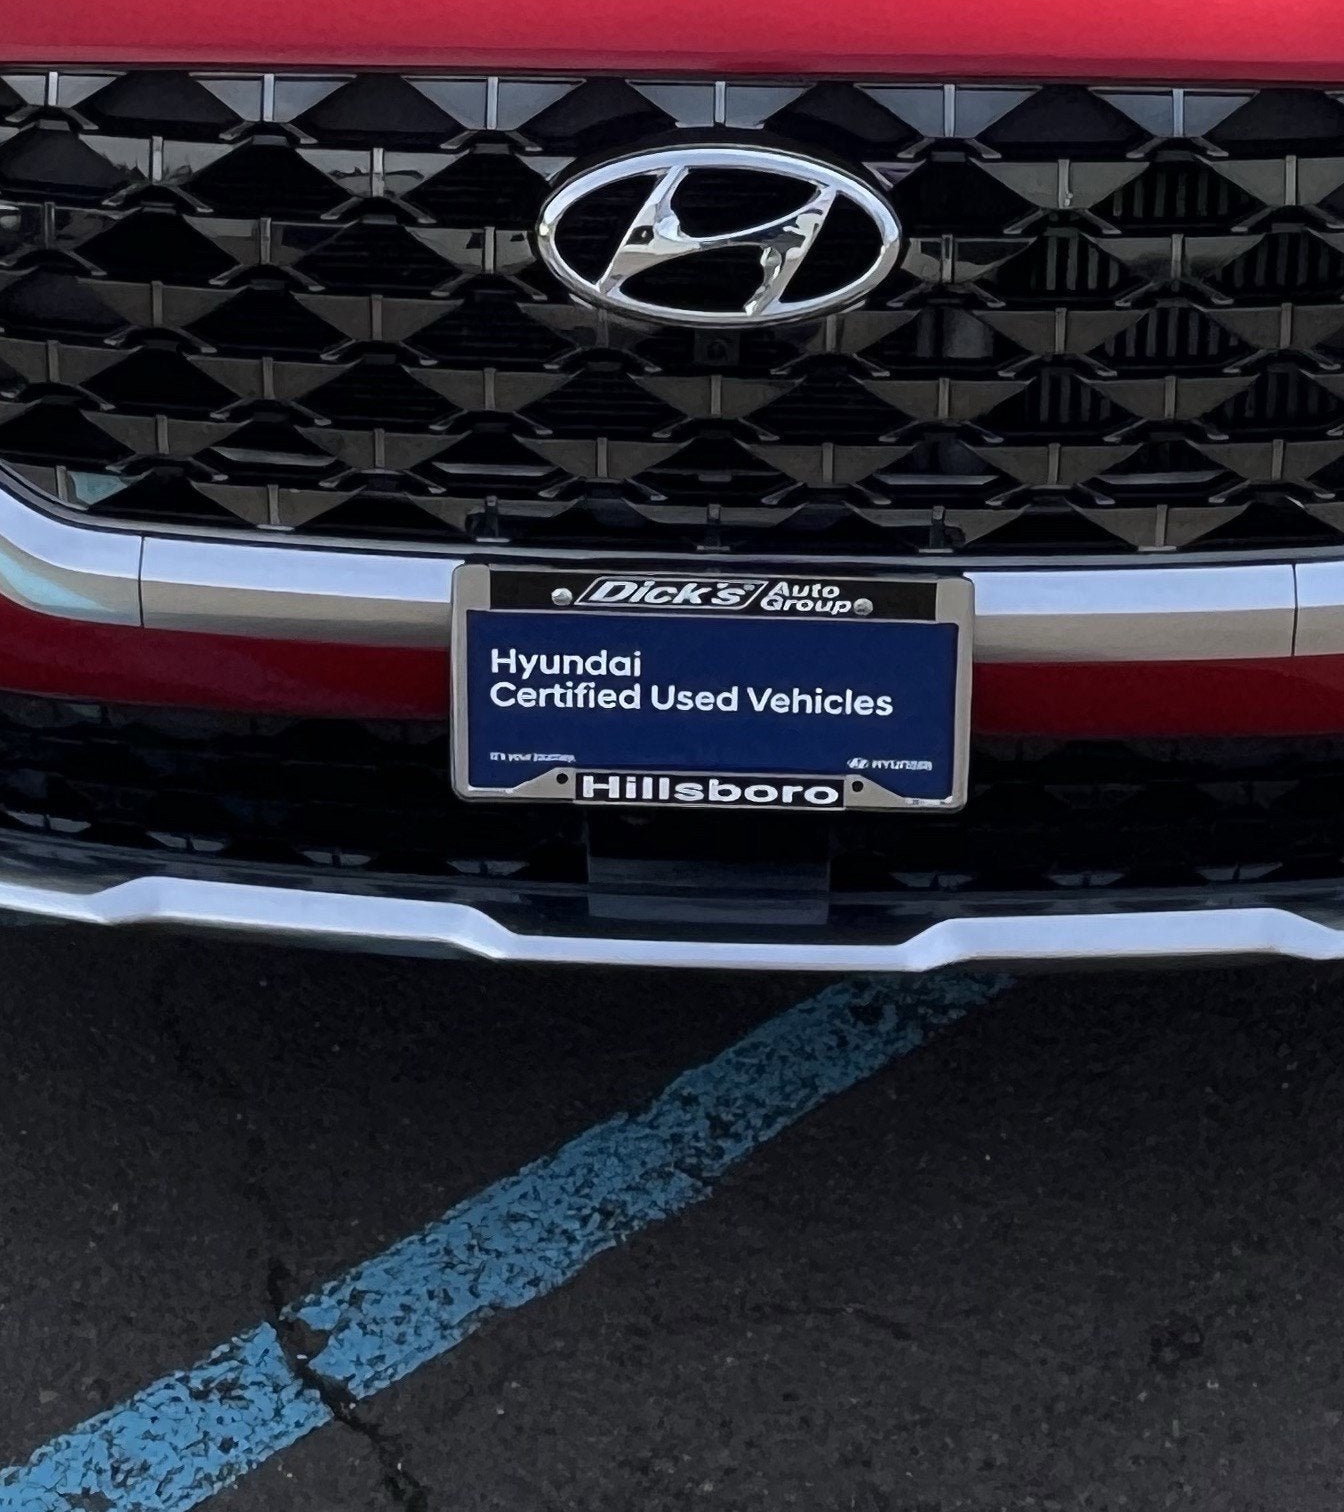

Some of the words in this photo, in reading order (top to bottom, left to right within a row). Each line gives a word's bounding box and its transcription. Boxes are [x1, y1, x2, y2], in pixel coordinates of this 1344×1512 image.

[588, 580, 746, 606] Dick's
[767, 581, 841, 598] Auto
[759, 594, 852, 616] Group
[490, 648, 642, 679] Hyundai
[489, 680, 641, 710] Certified
[650, 684, 739, 713] Used
[746, 687, 894, 717] Vehicles
[582, 775, 840, 805] Hillsboro
